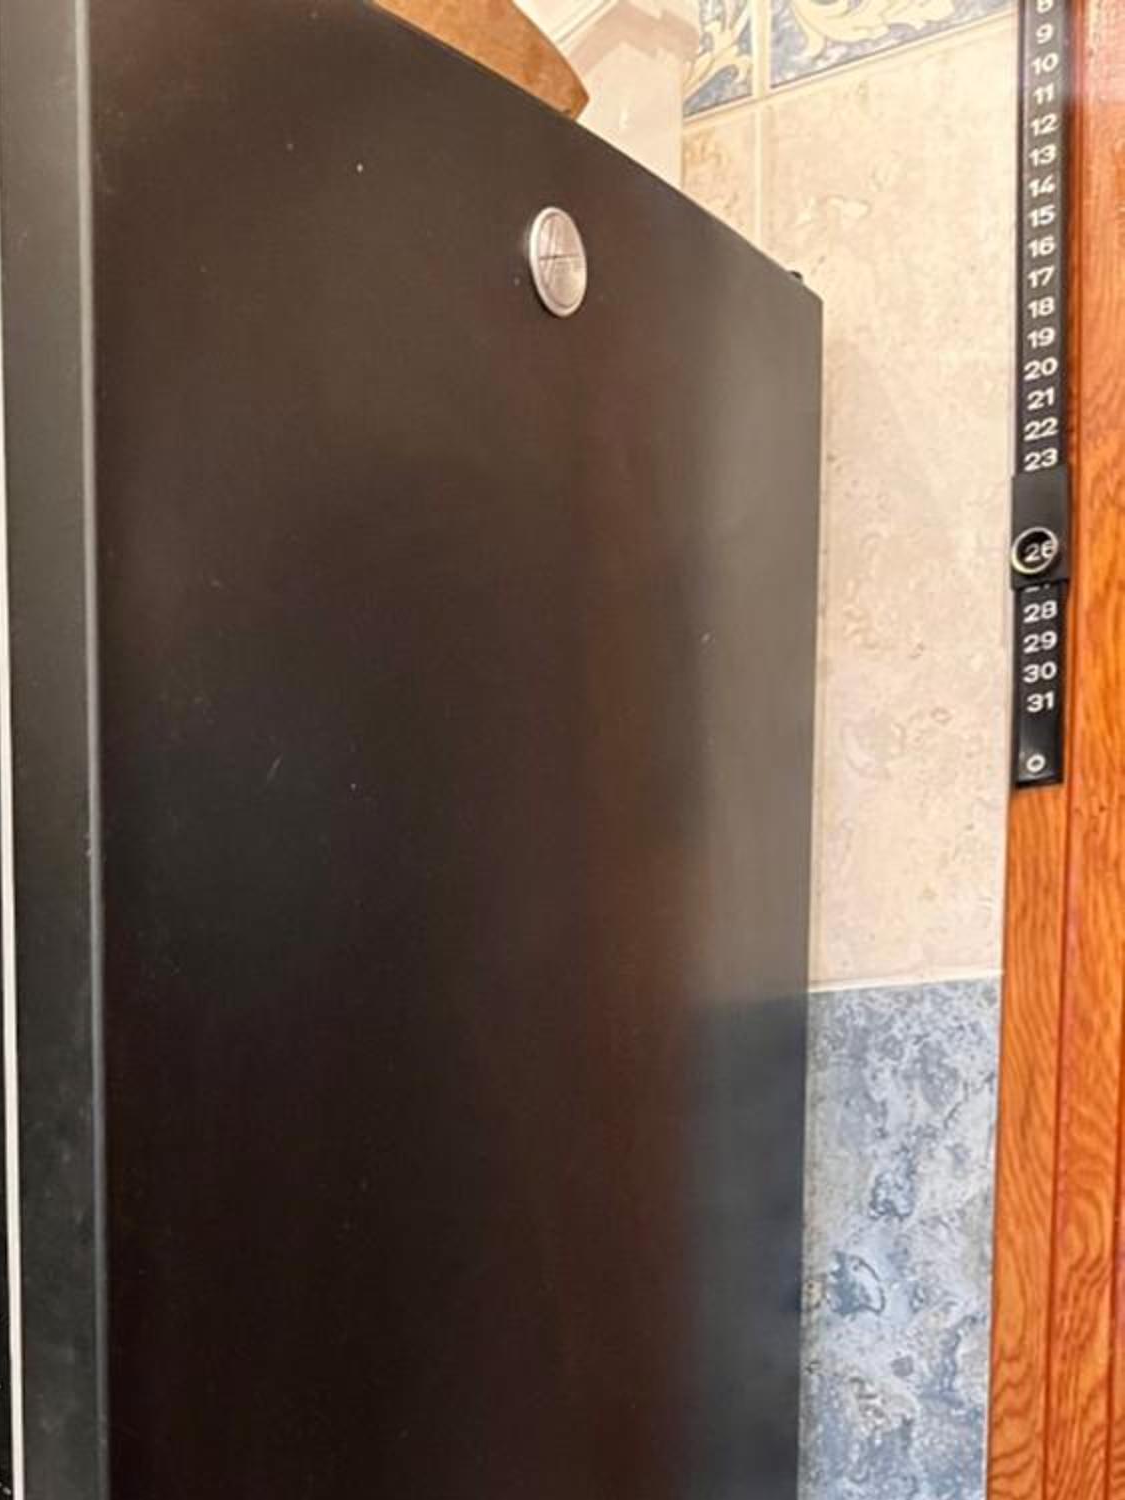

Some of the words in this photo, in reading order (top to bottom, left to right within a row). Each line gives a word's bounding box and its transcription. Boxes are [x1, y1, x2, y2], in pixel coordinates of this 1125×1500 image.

[1036, 23, 1053, 44] 9
[1032, 52, 1058, 74] 10
[1034, 83, 1054, 104] 11
[1031, 114, 1057, 136] 12
[1029, 144, 1056, 166] 13
[1029, 176, 1055, 197] 14
[1028, 204, 1055, 227] 15
[1028, 236, 1055, 257] 16
[1028, 266, 1055, 288] 17
[1028, 297, 1055, 318] 18
[1027, 327, 1055, 349] 19
[1024, 357, 1058, 381] 20
[1027, 387, 1054, 410] 21
[1024, 417, 1058, 441] 22
[1024, 448, 1058, 472] 23
[1024, 600, 1057, 623] 28
[1024, 631, 1057, 654] 29
[1023, 661, 1057, 683] 30
[1026, 691, 1054, 713] 31
